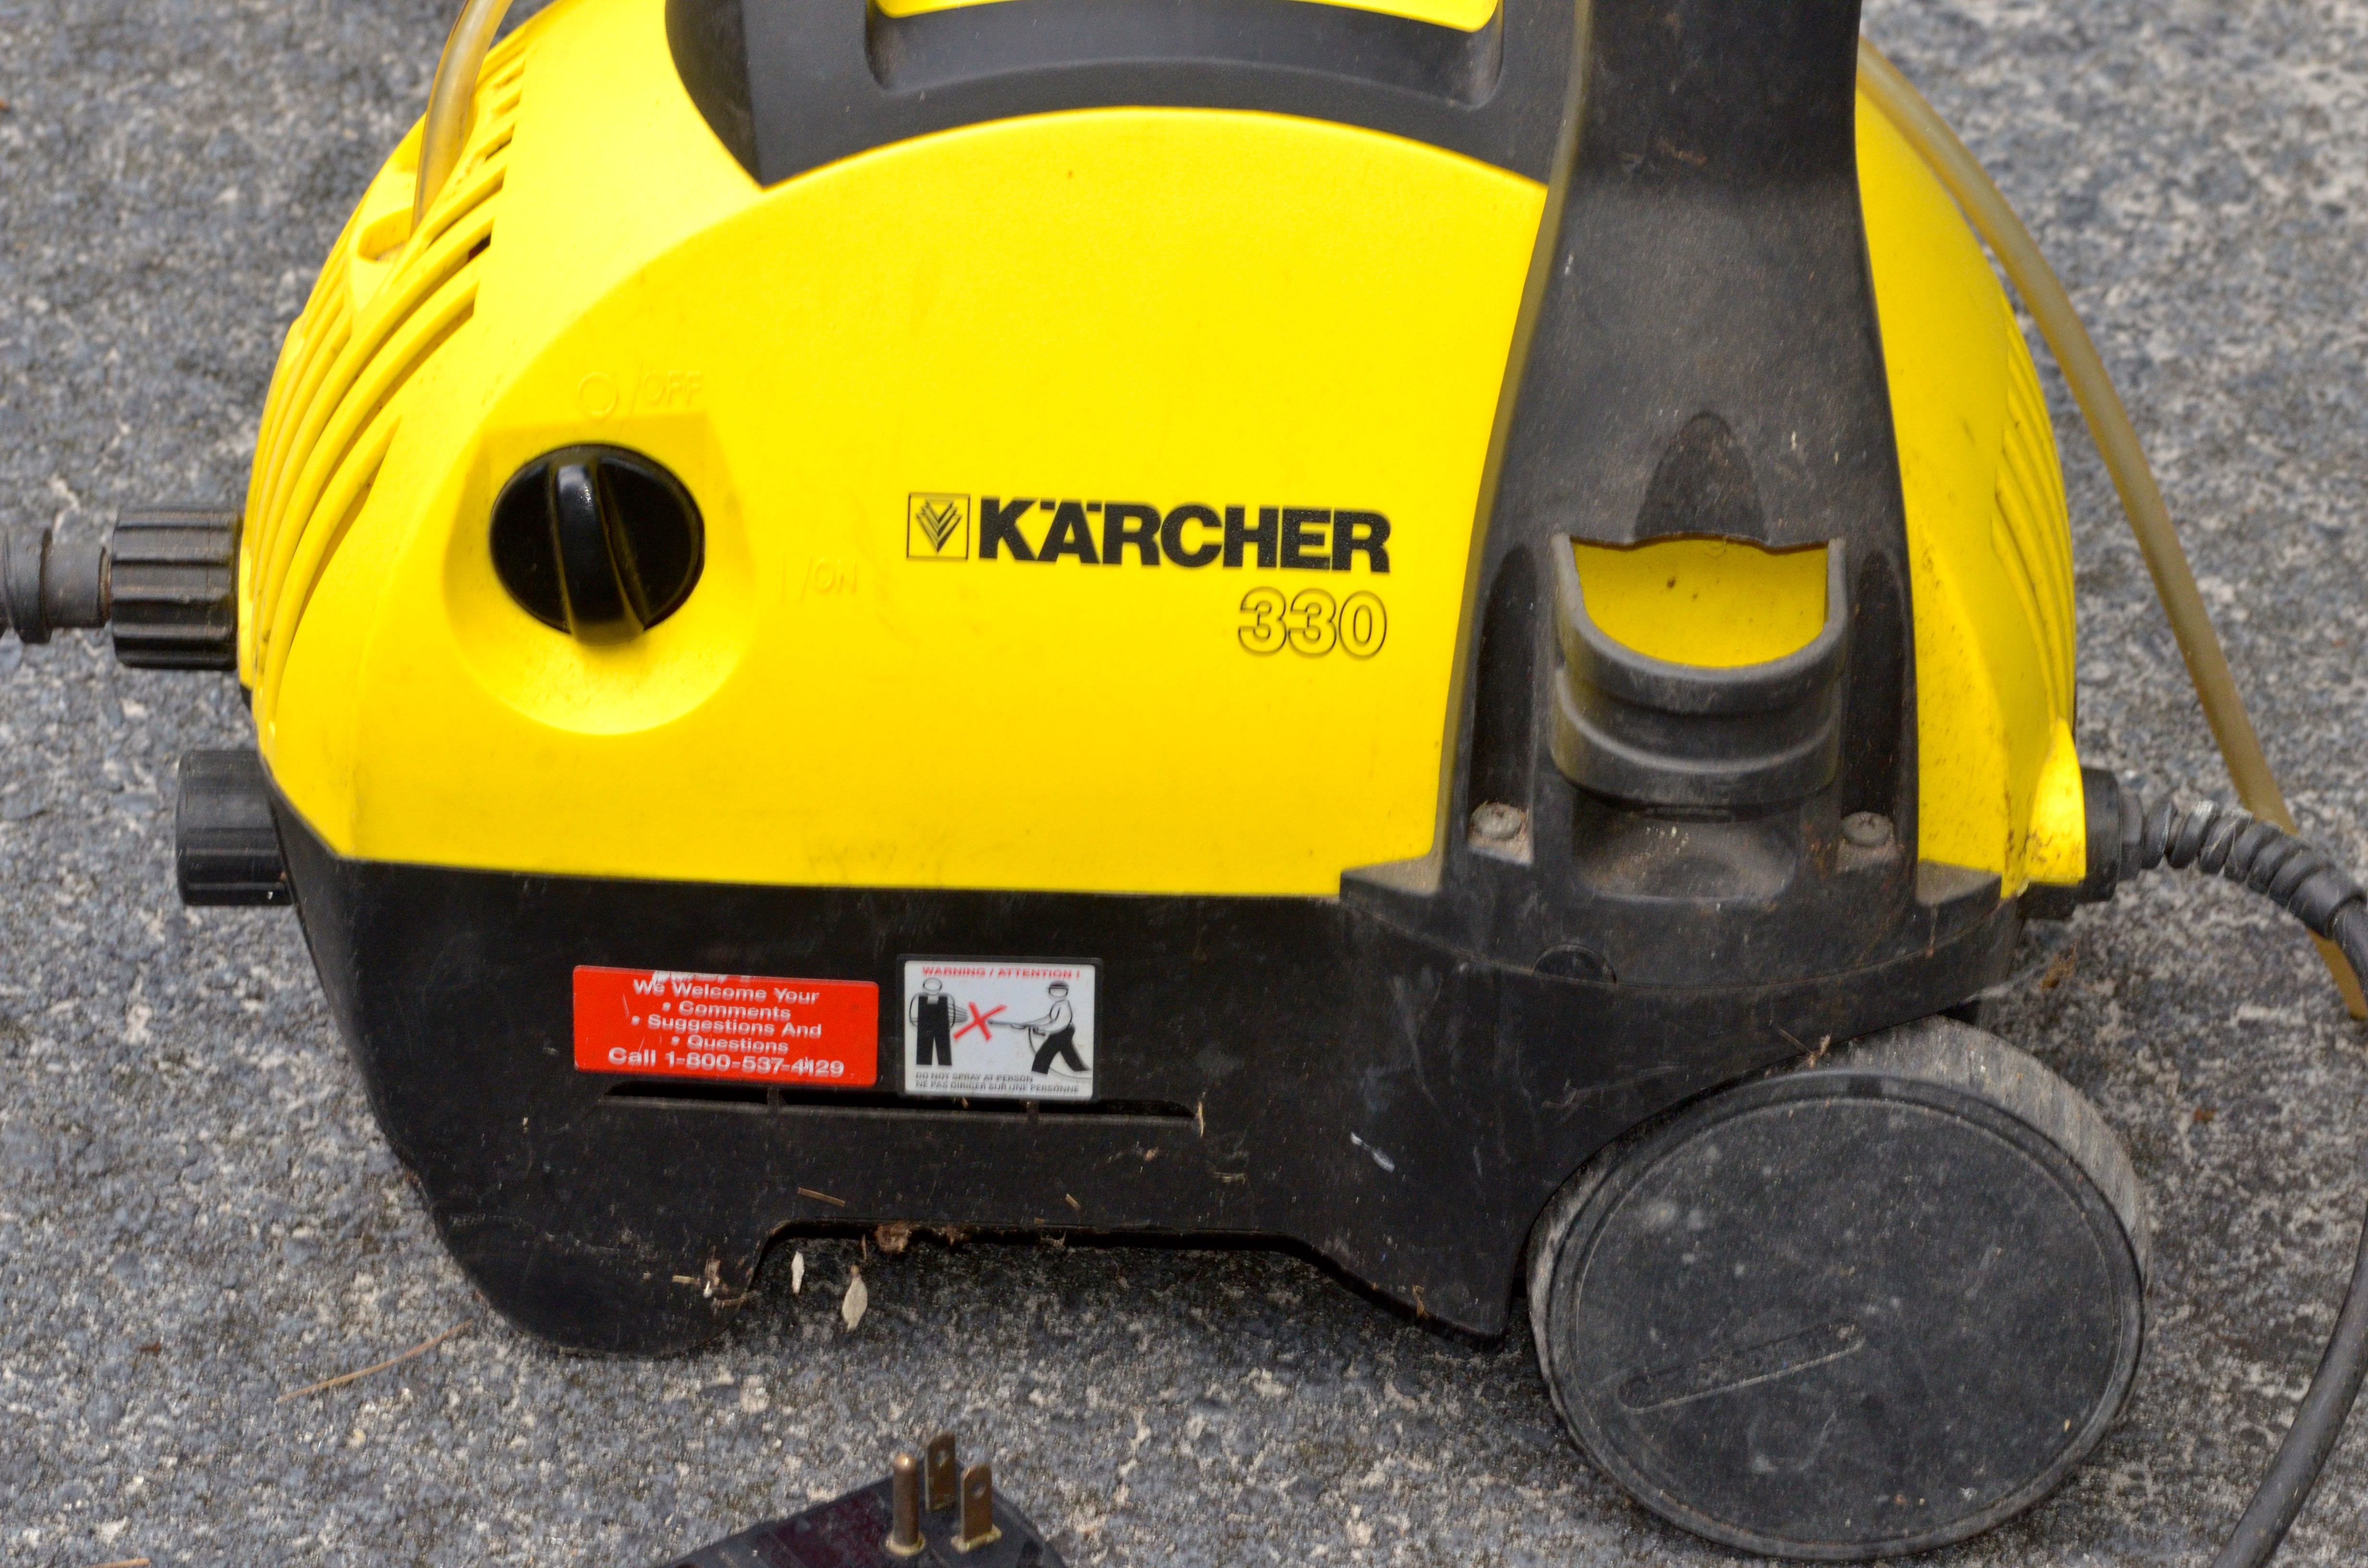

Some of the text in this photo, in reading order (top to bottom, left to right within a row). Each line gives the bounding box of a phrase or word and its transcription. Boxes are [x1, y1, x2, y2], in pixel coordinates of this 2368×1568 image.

[978, 496, 1391, 574] KÄRCHER
[1237, 587, 1387, 658] 330
[922, 966, 986, 977] WARNING
[998, 968, 1072, 978] ATTENTION
[633, 979, 820, 1005] We Welcome Your
[678, 1000, 791, 1022] Comments
[647, 1014, 822, 1039] Suggestions And
[686, 1034, 789, 1054] Questions
[608, 1047, 845, 1078] Call 1-800-537-4129
[950, 1081, 986, 1090] DIRIGER
[988, 1082, 1007, 1090] SUR
[1032, 1084, 1080, 1093] PERSONNE
[952, 1072, 981, 1081] SPRAY
[997, 1074, 1033, 1082] PERSON
